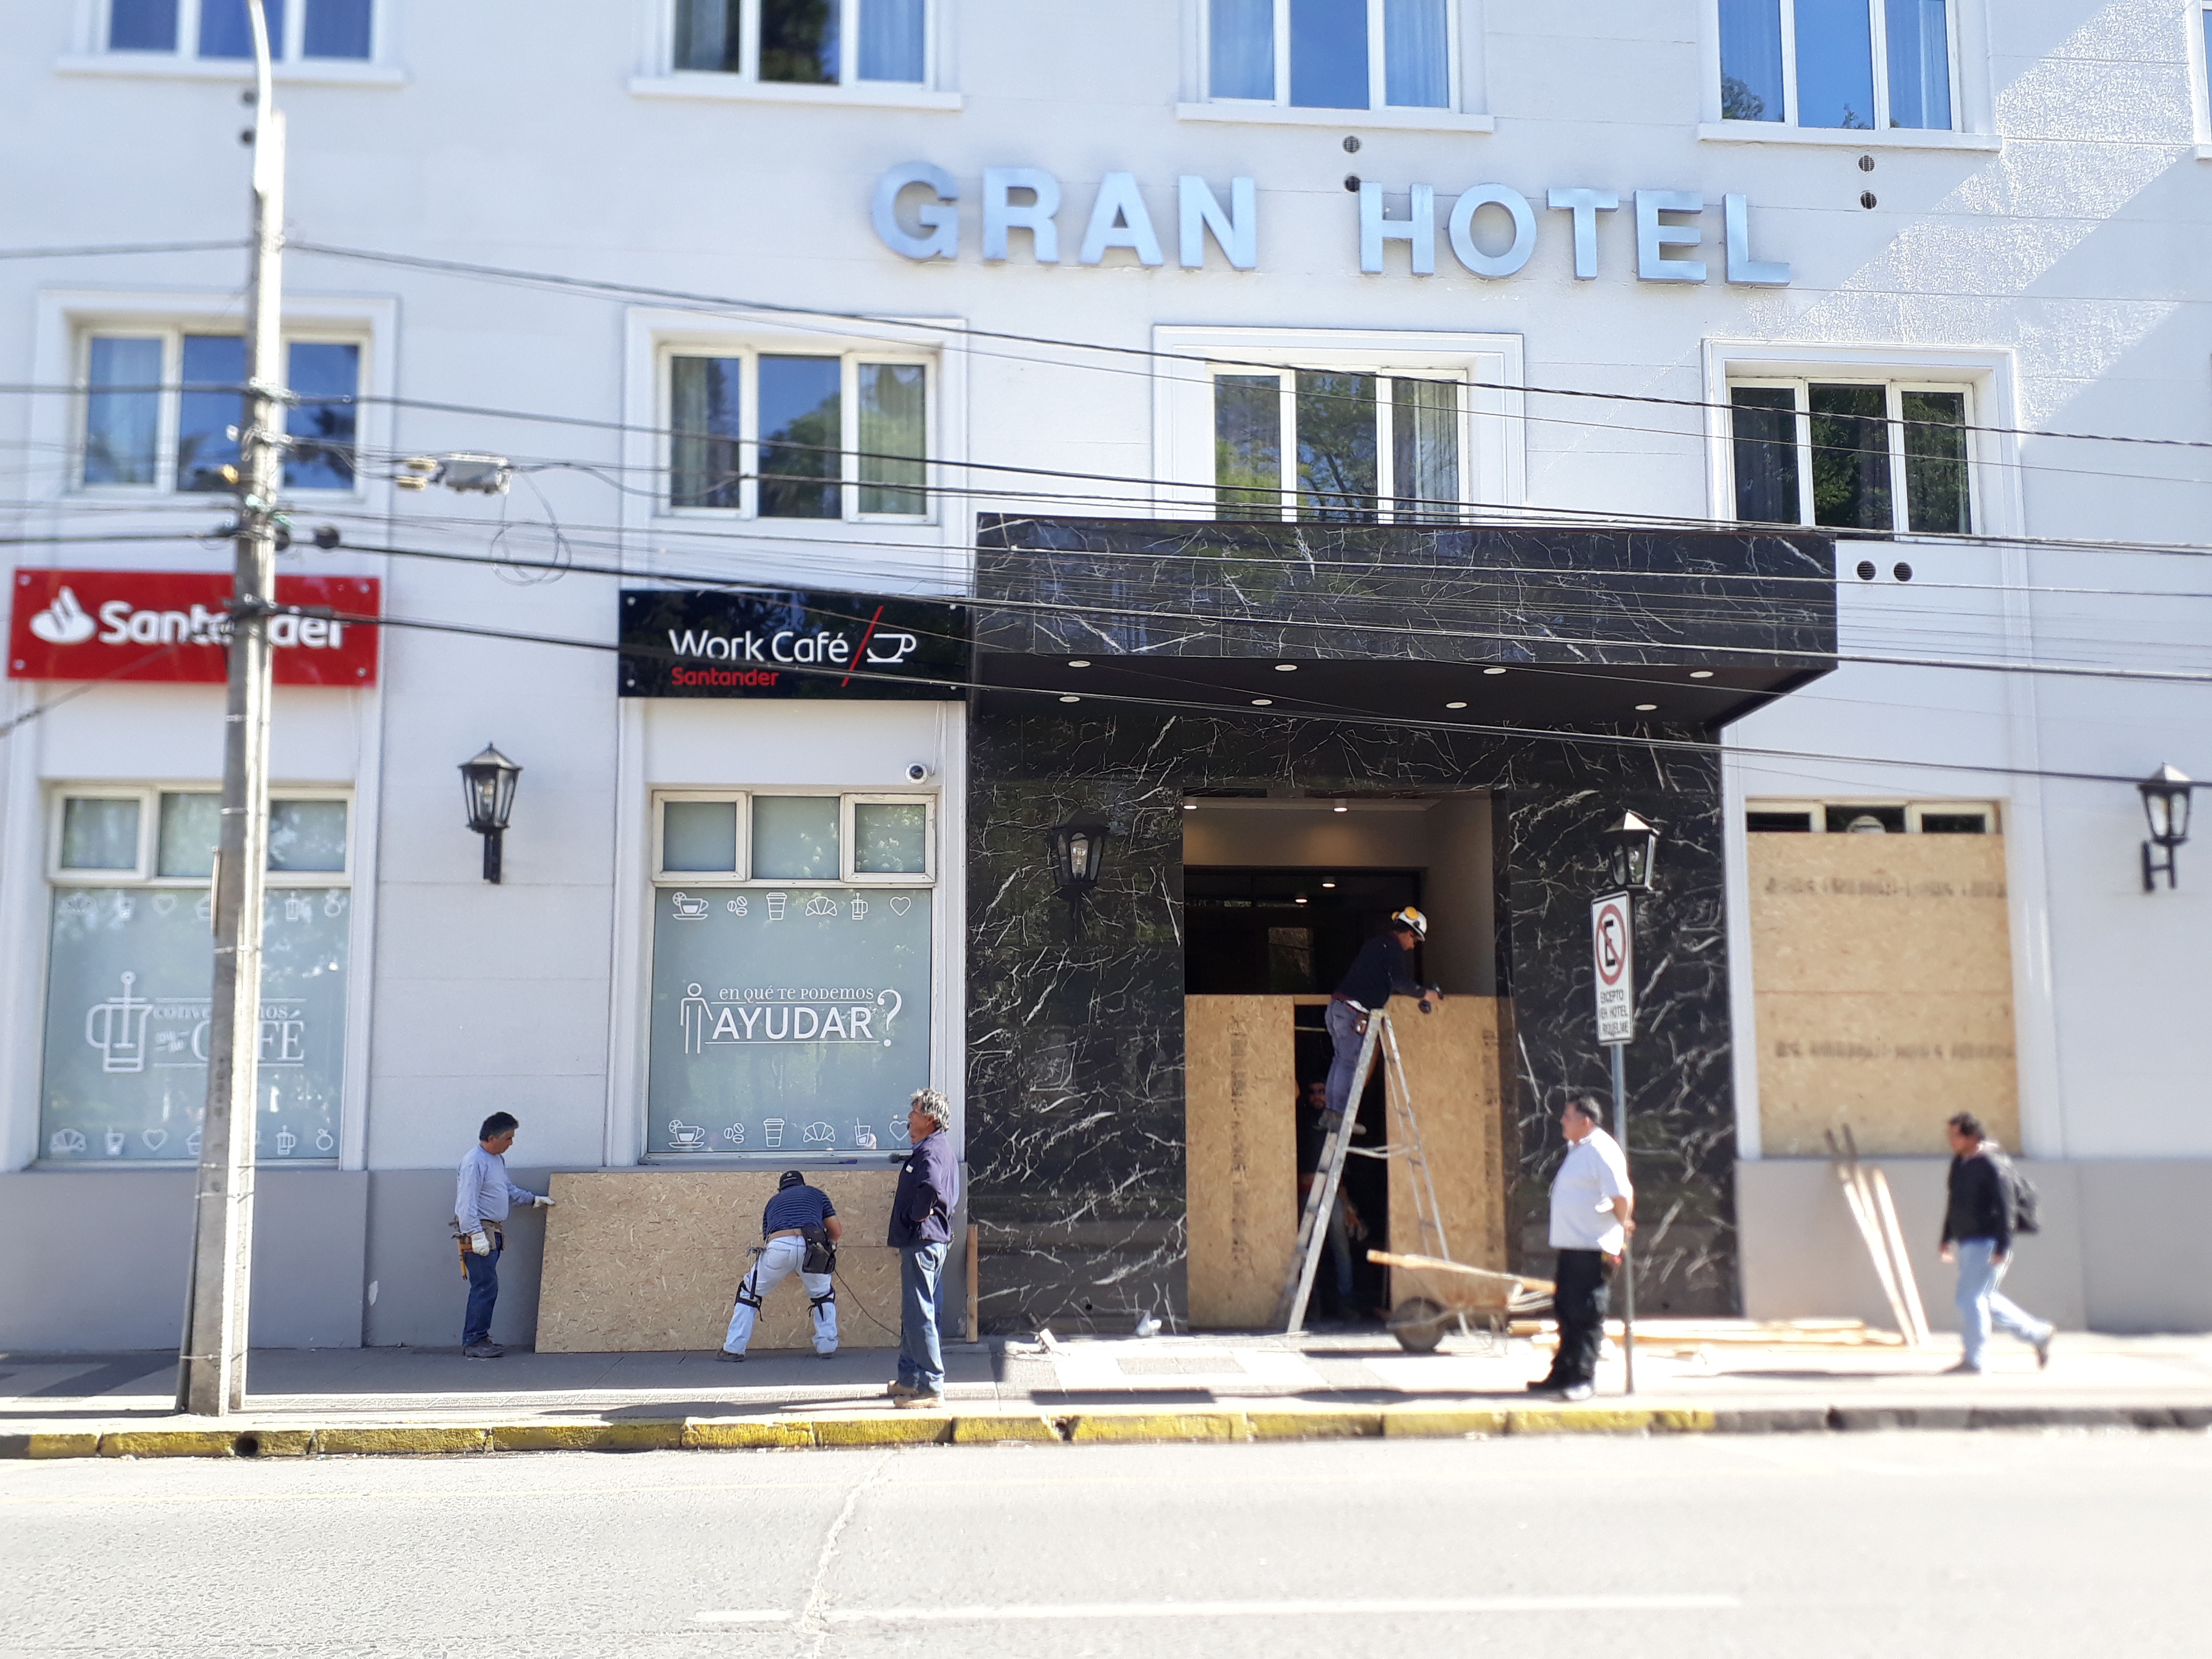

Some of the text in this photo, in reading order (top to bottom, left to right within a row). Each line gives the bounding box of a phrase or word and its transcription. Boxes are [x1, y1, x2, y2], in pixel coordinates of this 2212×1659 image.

[871, 161, 1791, 286] GRAN HOTEL
[99, 600, 343, 649] Santader
[668, 629, 849, 663] Work Café
[671, 666, 780, 686] Santander
[719, 988, 740, 1000] en
[191, 1008, 304, 1062] CFÉ
